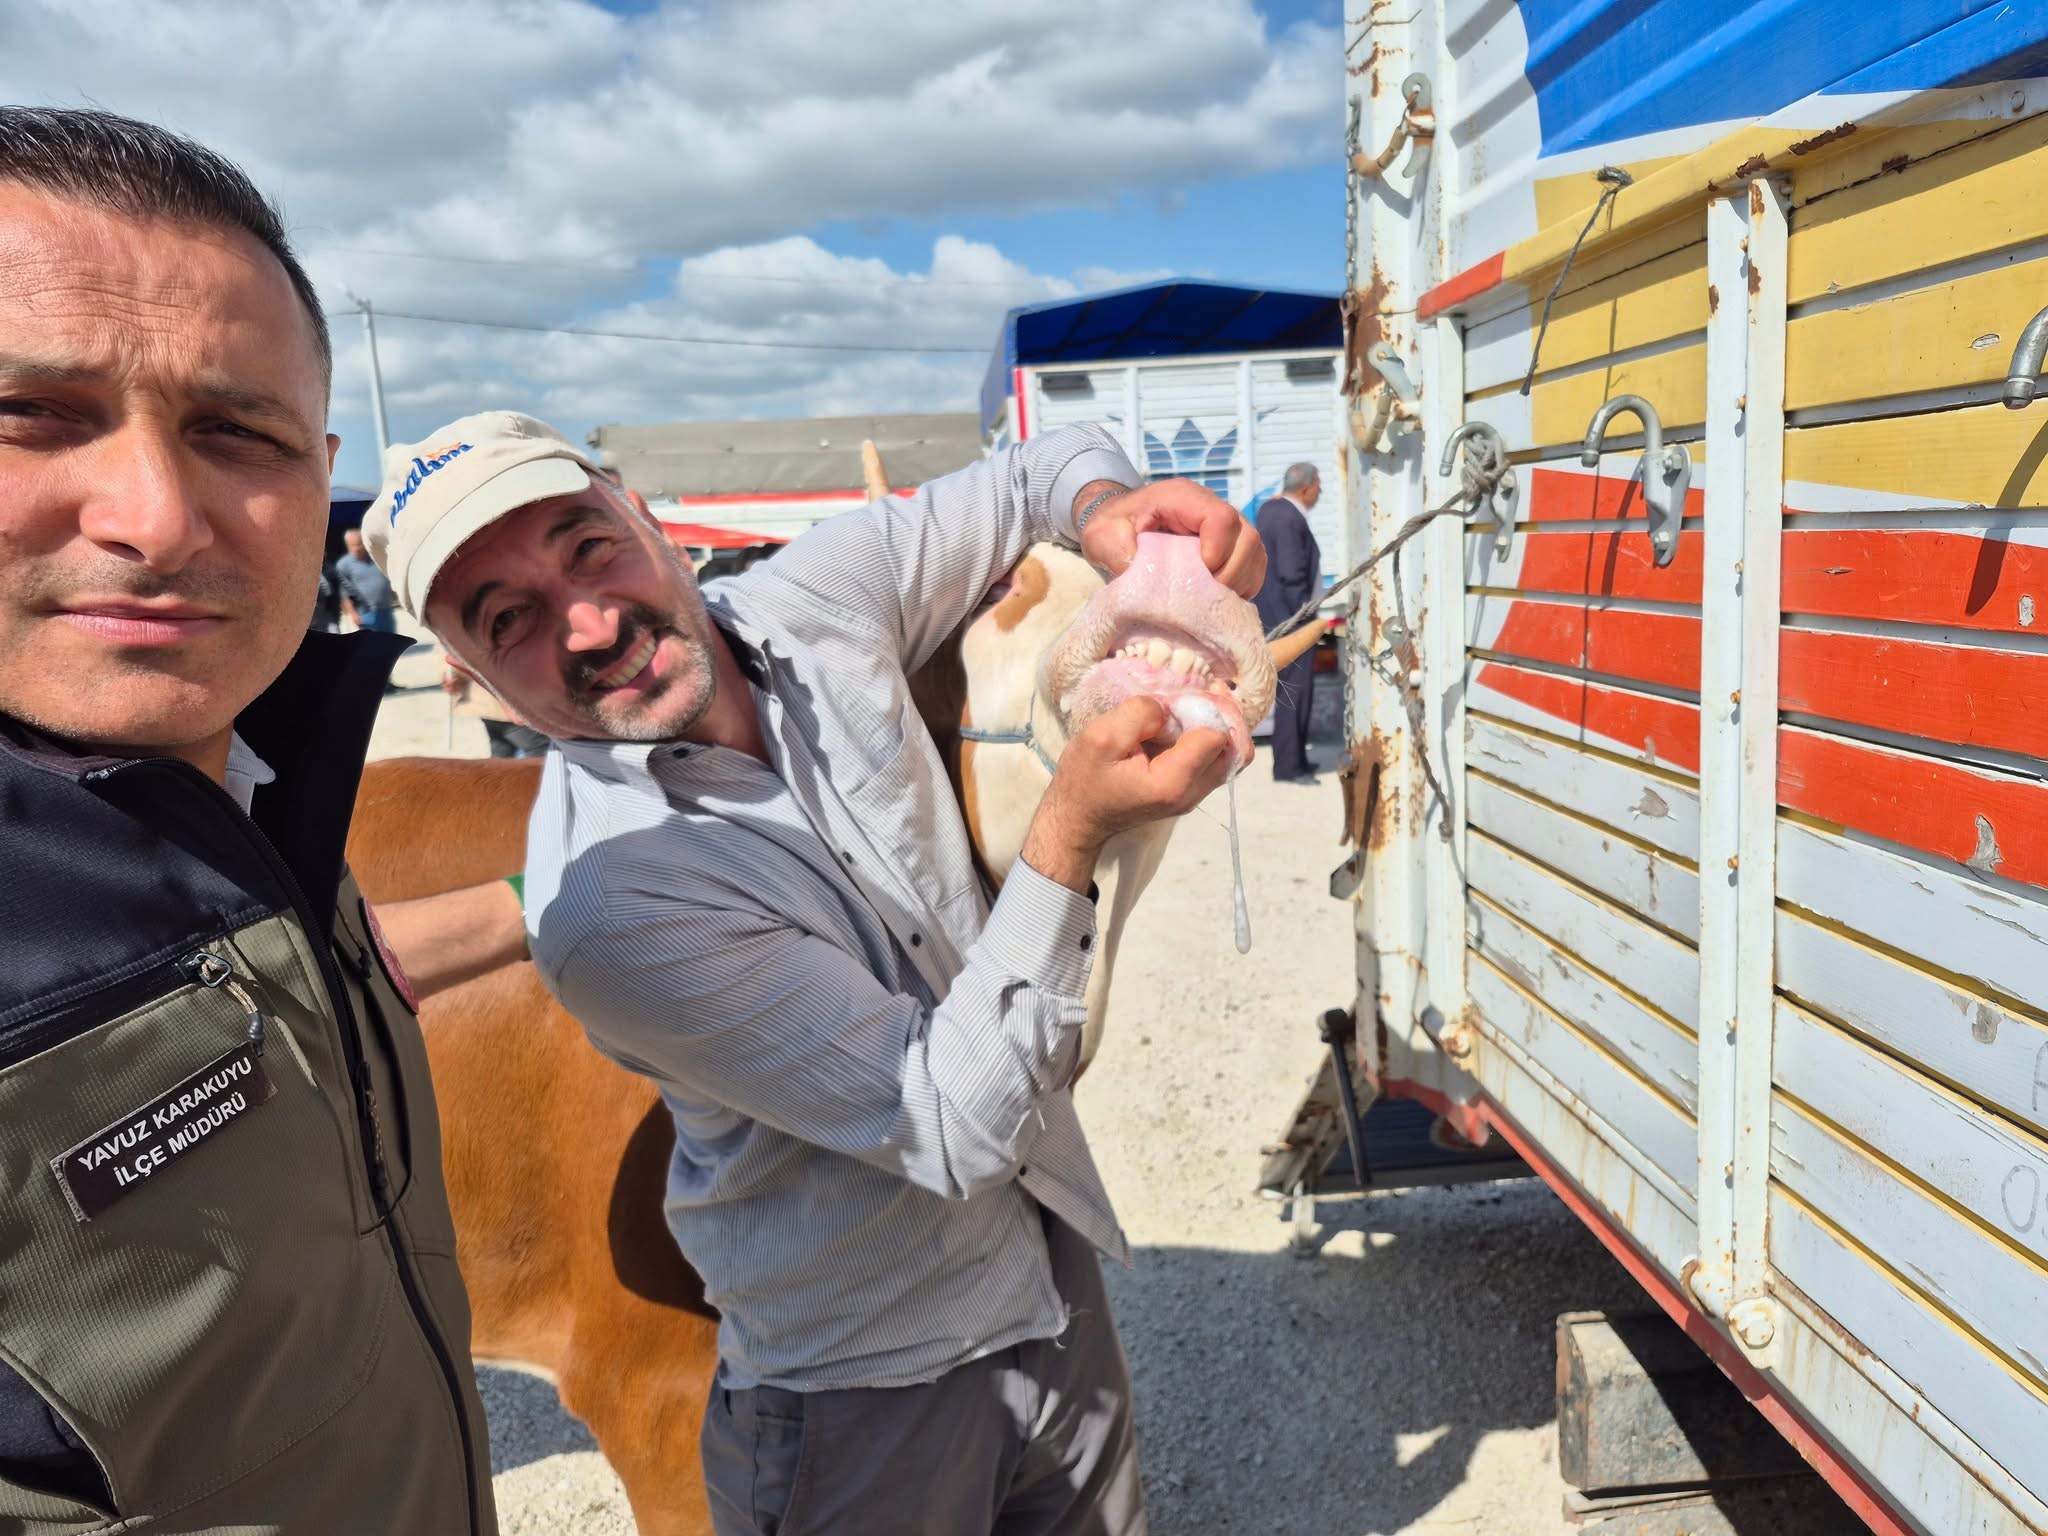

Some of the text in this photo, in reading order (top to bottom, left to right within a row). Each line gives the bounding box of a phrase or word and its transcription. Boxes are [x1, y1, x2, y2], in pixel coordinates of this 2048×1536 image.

[77, 1056, 252, 1171] YAVUZ KARAKUYU
[113, 1091, 246, 1187] İLÇE MÜDÜRÜ
